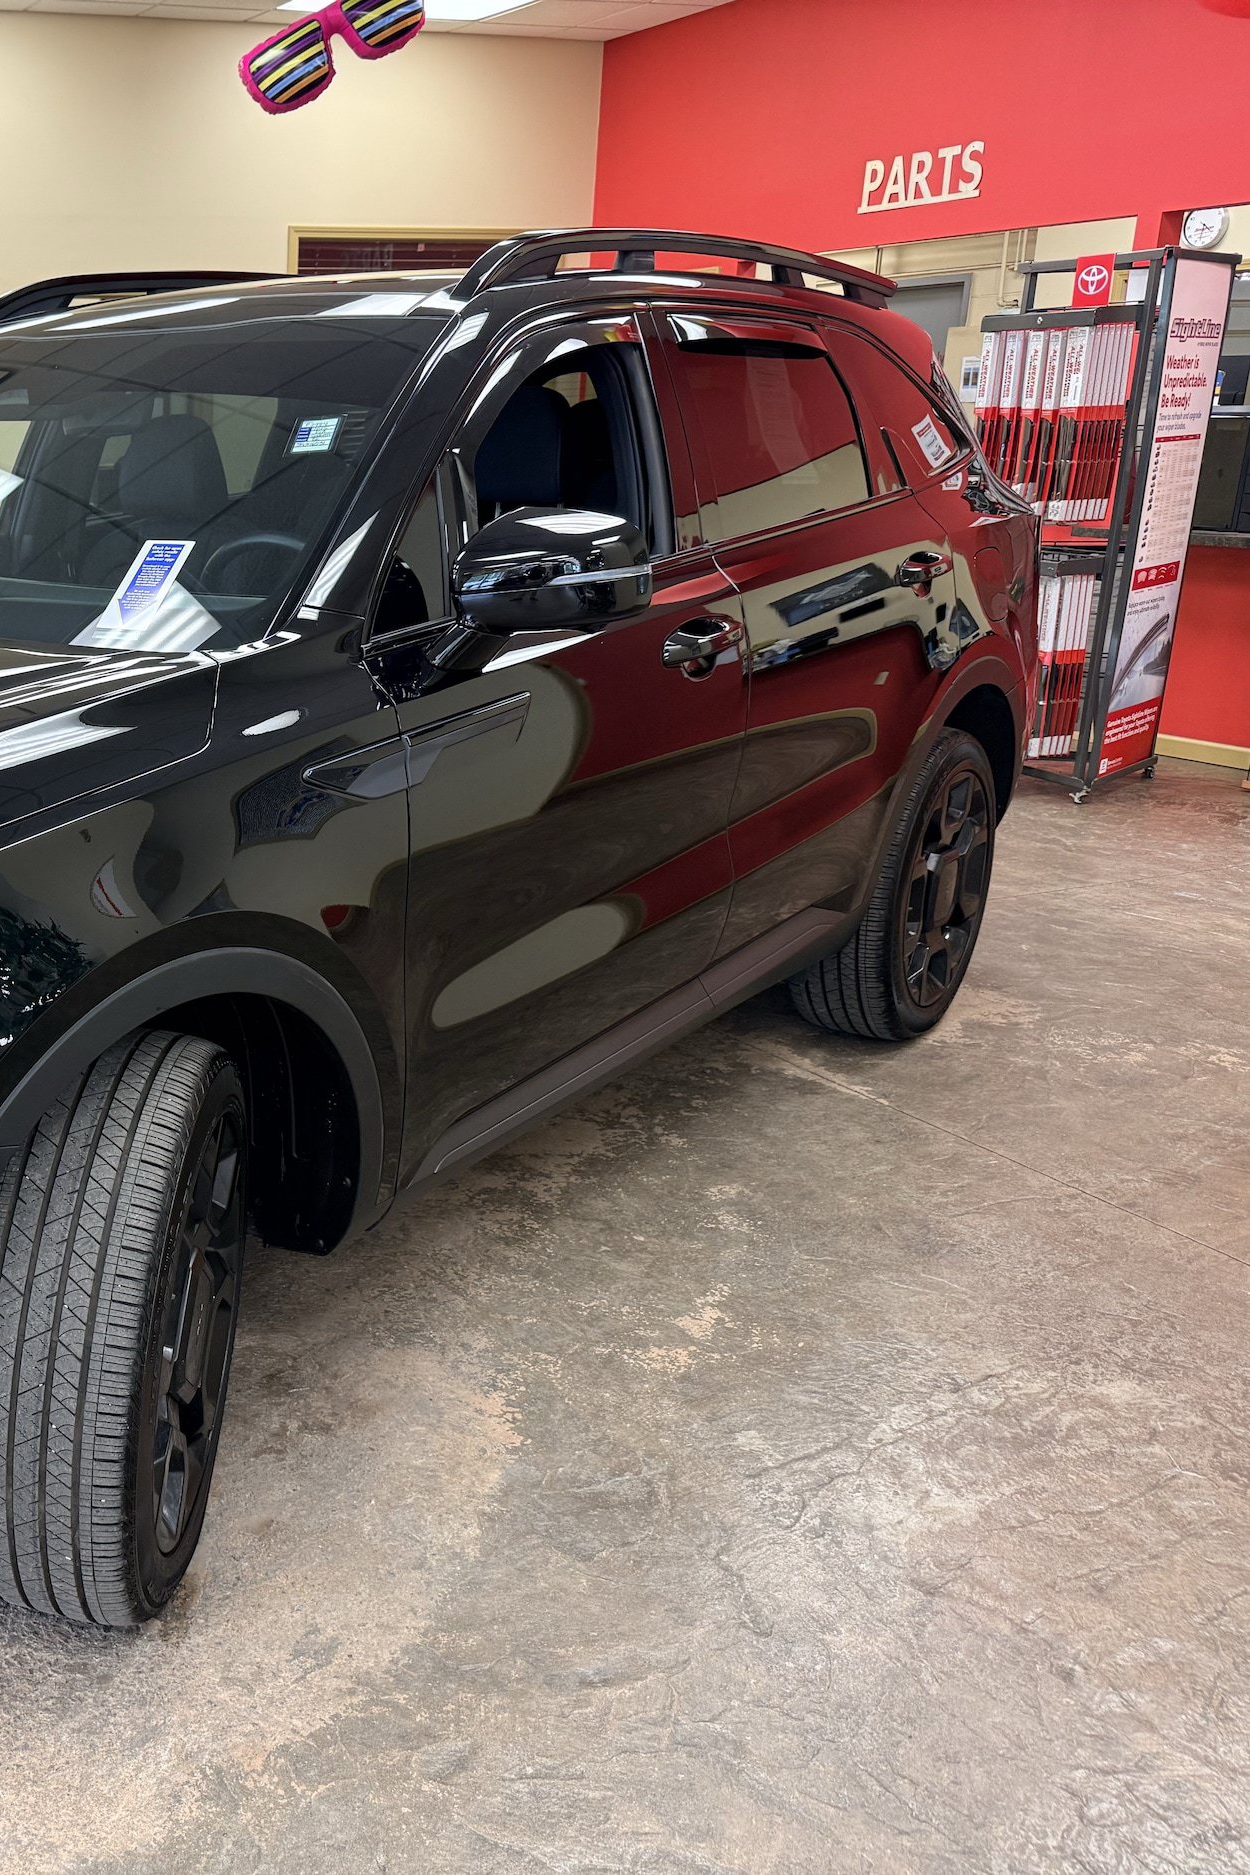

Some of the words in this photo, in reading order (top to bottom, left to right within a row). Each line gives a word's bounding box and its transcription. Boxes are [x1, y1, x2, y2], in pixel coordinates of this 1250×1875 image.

[857, 141, 985, 213] PARTS
[1170, 318, 1221, 342] SightLine
[1166, 354, 1194, 370] Weather
[1193, 354, 1200, 369] is
[1164, 372, 1207, 391] Unpredictable.
[1161, 394, 1169, 408] Be
[1169, 393, 1192, 410] Ready!
